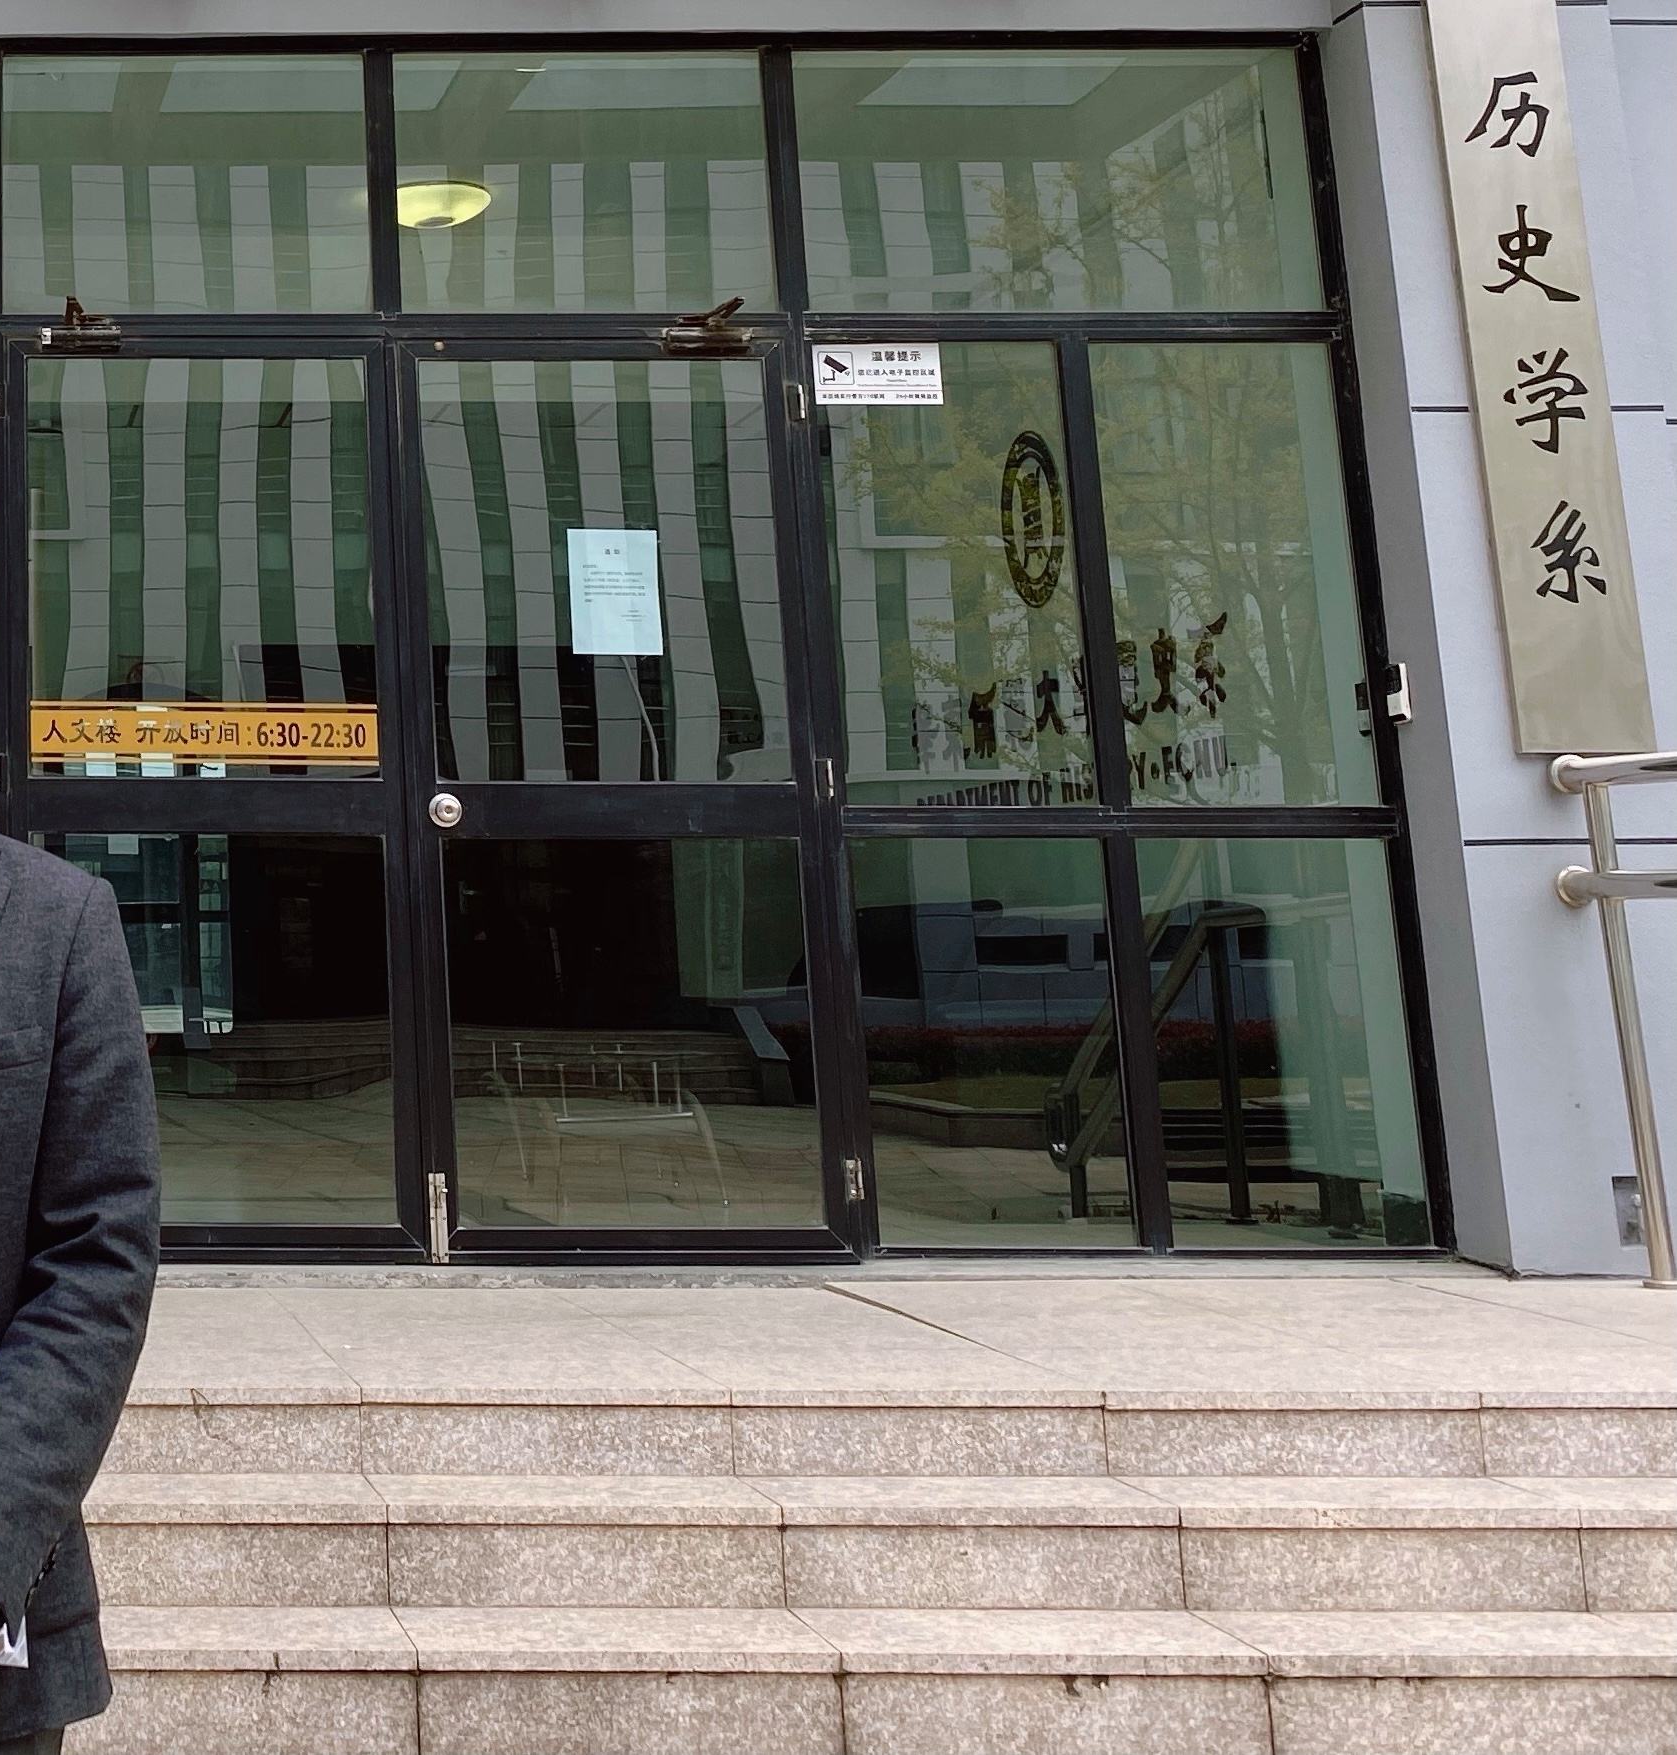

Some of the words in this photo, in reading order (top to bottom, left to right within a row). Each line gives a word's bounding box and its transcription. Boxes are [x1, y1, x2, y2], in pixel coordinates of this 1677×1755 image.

[1464, 71, 1607, 604] 历史学系
[42, 717, 122, 745] 人文楼
